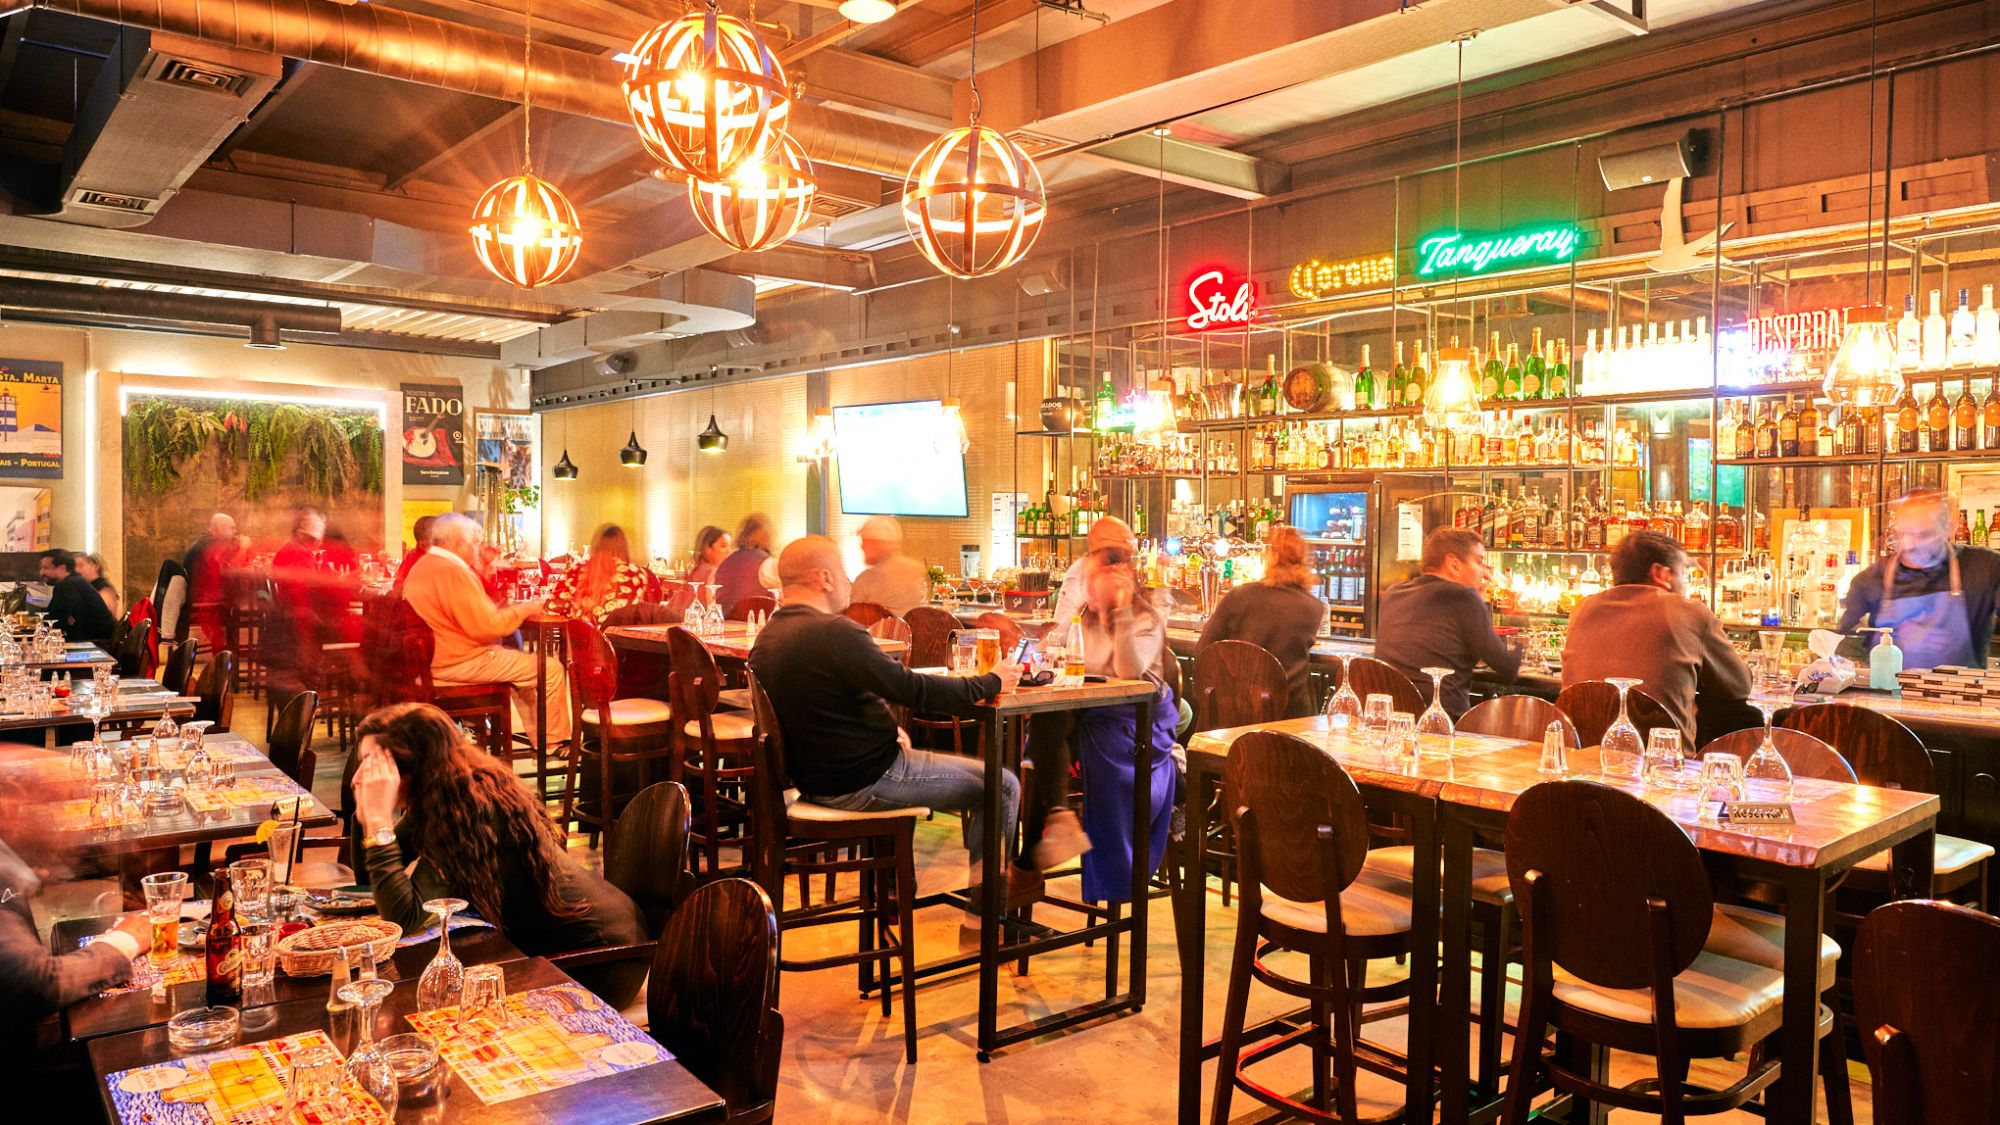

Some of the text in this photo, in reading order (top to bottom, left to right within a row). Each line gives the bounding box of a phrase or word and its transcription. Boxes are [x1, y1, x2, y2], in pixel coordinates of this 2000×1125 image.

[1420, 227, 1579, 274] Tanqueray
[1289, 257, 1394, 301] Corona
[23, 372, 59, 384] MARTA
[405, 396, 463, 416] FADO
